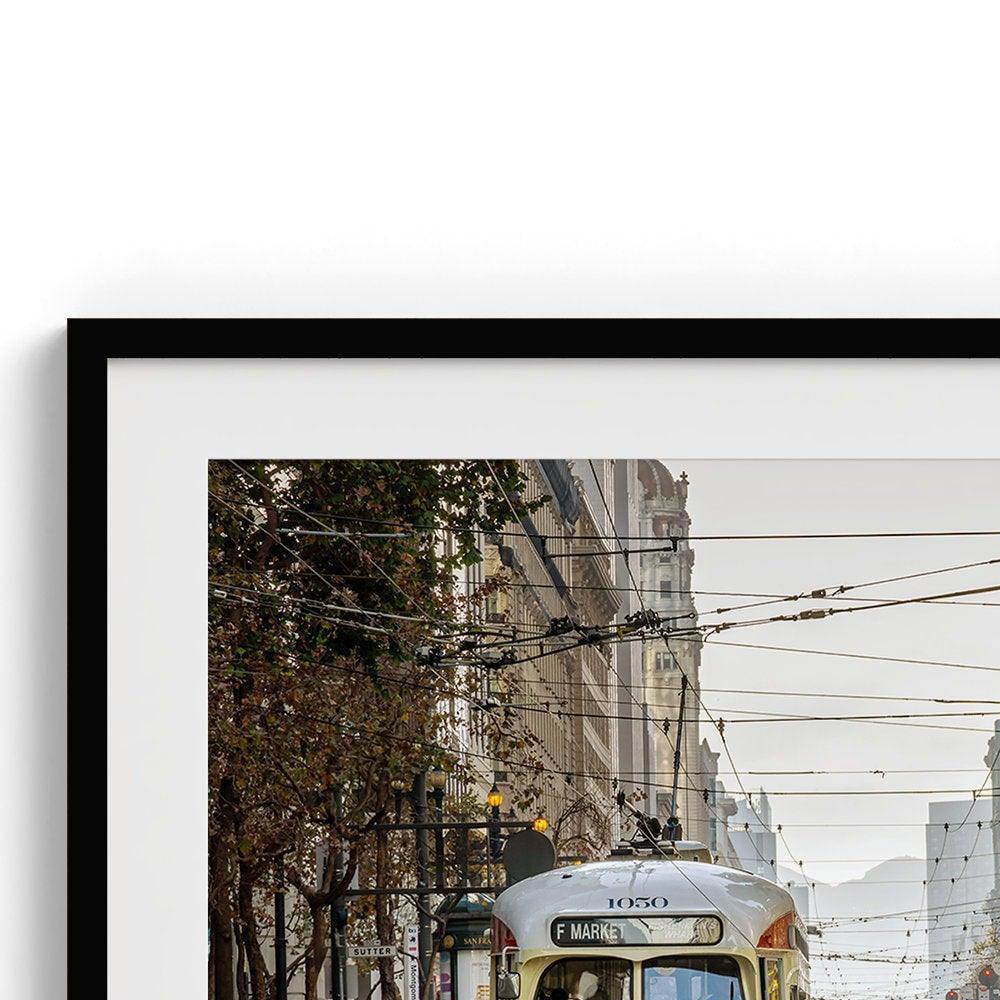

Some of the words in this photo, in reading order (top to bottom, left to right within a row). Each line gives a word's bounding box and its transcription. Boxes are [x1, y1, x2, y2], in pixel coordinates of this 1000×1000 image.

[607, 896, 669, 909] 1050
[557, 924, 565, 939] F
[571, 923, 626, 940] MARKET
[354, 948, 391, 956] SUTTER
